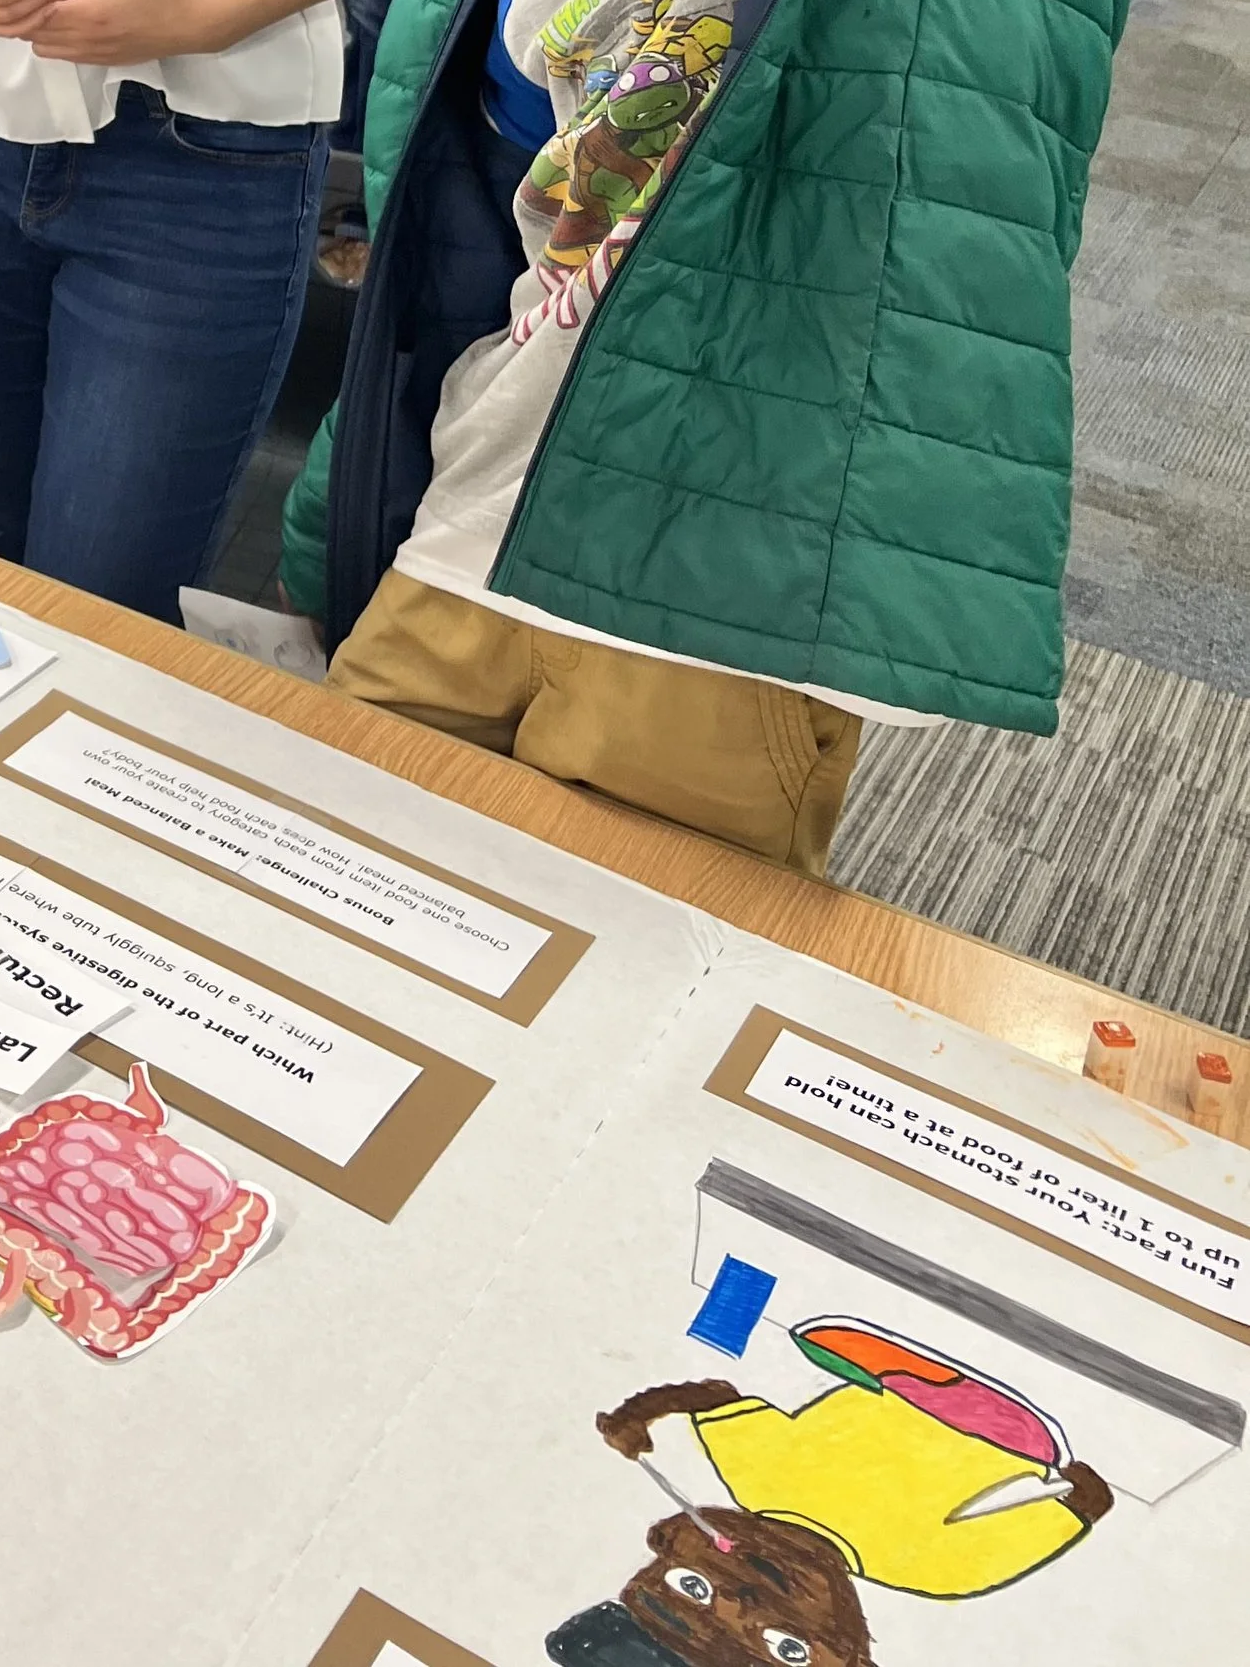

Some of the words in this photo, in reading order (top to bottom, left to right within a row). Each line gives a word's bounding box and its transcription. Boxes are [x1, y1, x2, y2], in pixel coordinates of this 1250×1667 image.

[82, 749, 112, 766] own
[101, 748, 144, 771] body?
[110, 764, 145, 782] your
[143, 767, 178, 786] your
[83, 776, 122, 799] Meal
[145, 778, 189, 803] create
[177, 782, 209, 802] help
[121, 794, 193, 832] Balanced
[190, 800, 206, 813] to
[207, 796, 243, 816] food
[194, 828, 207, 837] a
[206, 807, 269, 840] category
[243, 811, 278, 831] each
[207, 834, 251, 858] Make
[273, 835, 308, 857] each
[281, 827, 317, 848] does
[310, 854, 346, 876] from
[317, 846, 352, 866] How
[255, 854, 340, 900] Challenge:
[347, 871, 383, 894] item
[357, 862, 397, 886] meal.
[7, 883, 59, 915] where
[382, 889, 419, 911] food
[396, 883, 467, 920] balanced
[342, 897, 395, 927] Bonus
[421, 906, 451, 924] one
[61, 911, 101, 937] tube
[453, 921, 511, 952] Choose
[102, 932, 177, 973] squiggly
[51, 941, 139, 989] digestive
[182, 969, 225, 999] long,
[141, 987, 176, 1010] the
[227, 994, 241, 1006] a
[174, 1006, 201, 1021] of
[202, 1018, 250, 1046] part
[278, 1021, 334, 1054] (Hint:
[251, 1043, 315, 1084] Which
[783, 1075, 844, 1110] hold
[825, 1074, 895, 1114] time!
[848, 1103, 896, 1130] can
[903, 1108, 920, 1123] a
[925, 1118, 955, 1139] at
[902, 1127, 1021, 1187] stomach
[960, 1135, 1024, 1172] food
[1029, 1168, 1061, 1187] of
[1024, 1186, 1091, 1226] Your
[1067, 1186, 1128, 1222] liter
[1139, 1216, 1155, 1233] 1
[1101, 1219, 1172, 1263] Fact:
[1164, 1230, 1194, 1252] to
[1203, 1247, 1241, 1270] up
[1180, 1256, 1236, 1291] Fun
